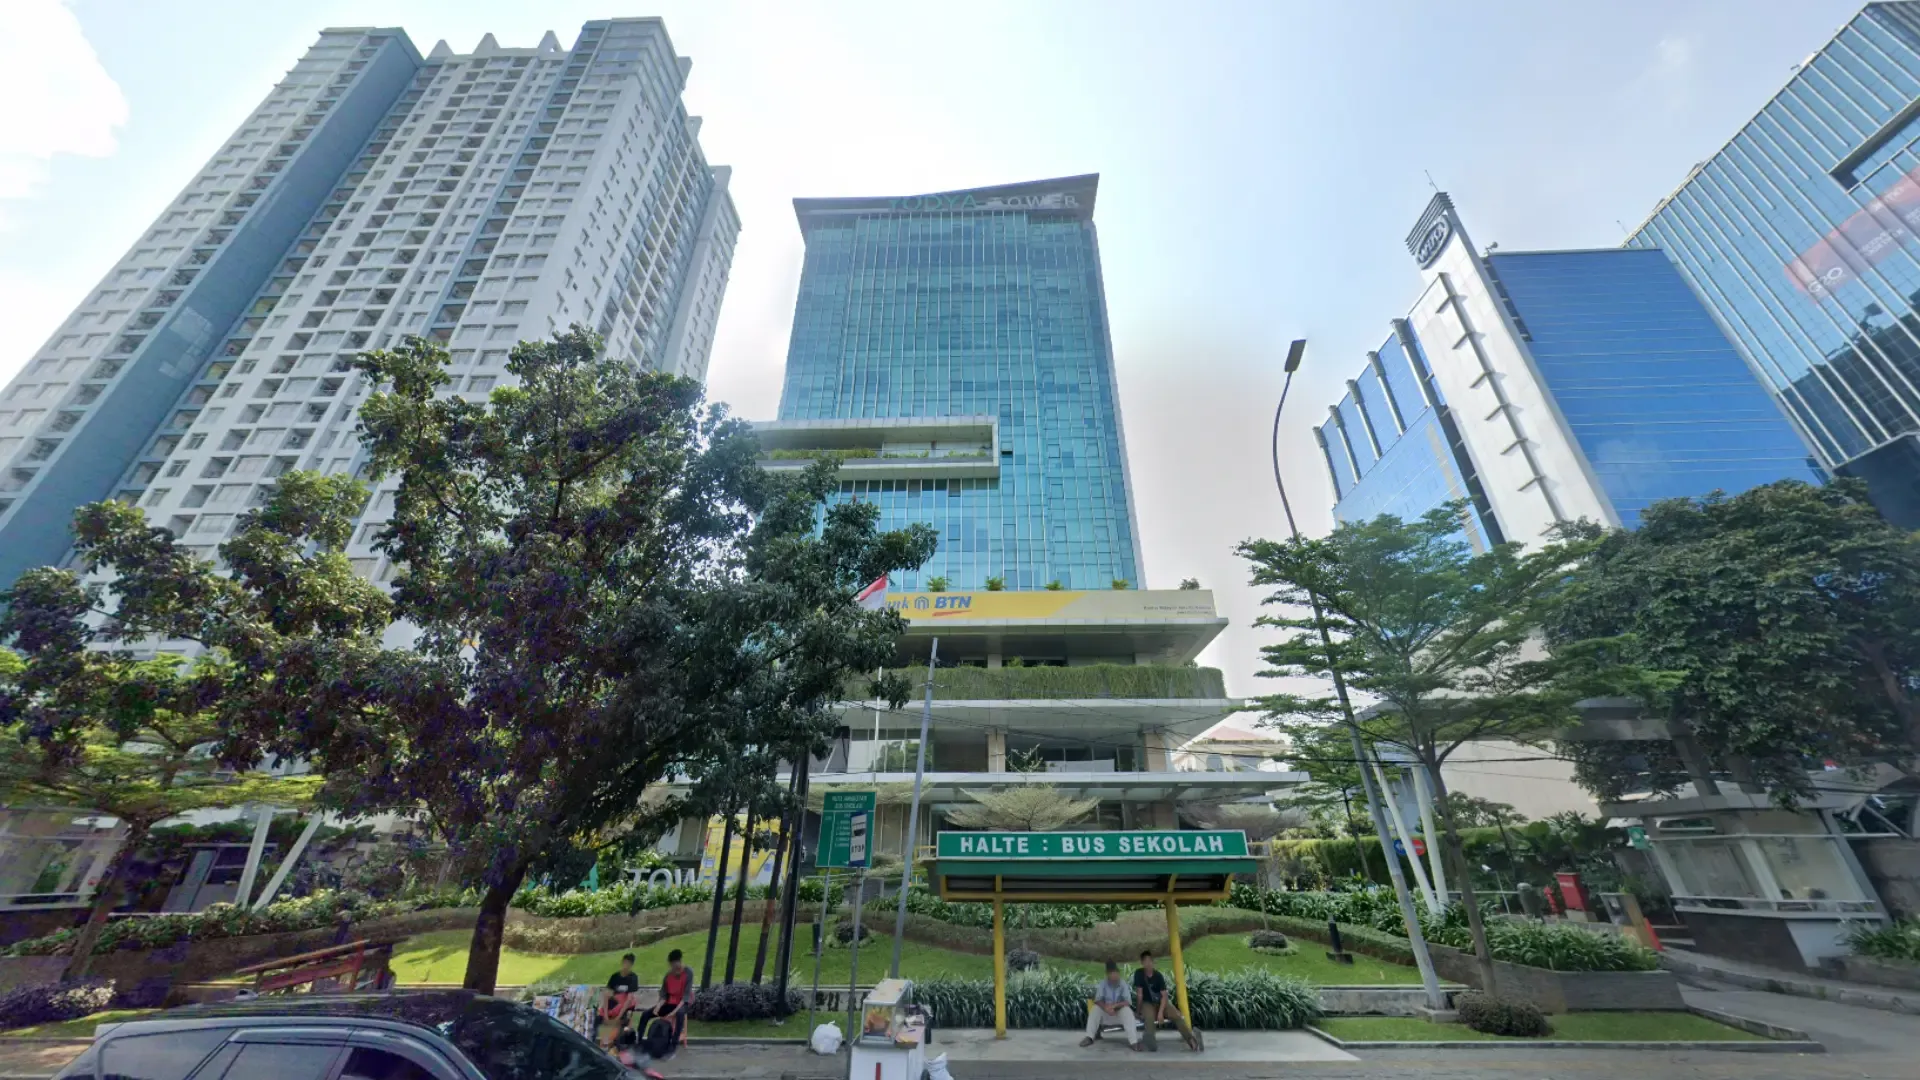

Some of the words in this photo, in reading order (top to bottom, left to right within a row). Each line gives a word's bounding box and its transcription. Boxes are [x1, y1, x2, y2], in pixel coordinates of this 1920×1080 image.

[888, 194, 977, 211] YODYA
[986, 192, 1080, 209] TOWER
[935, 595, 972, 609] BTN
[960, 836, 1029, 853] HALTE
[1061, 836, 1106, 853] BUS
[1118, 835, 1224, 853] SEKOLAH
